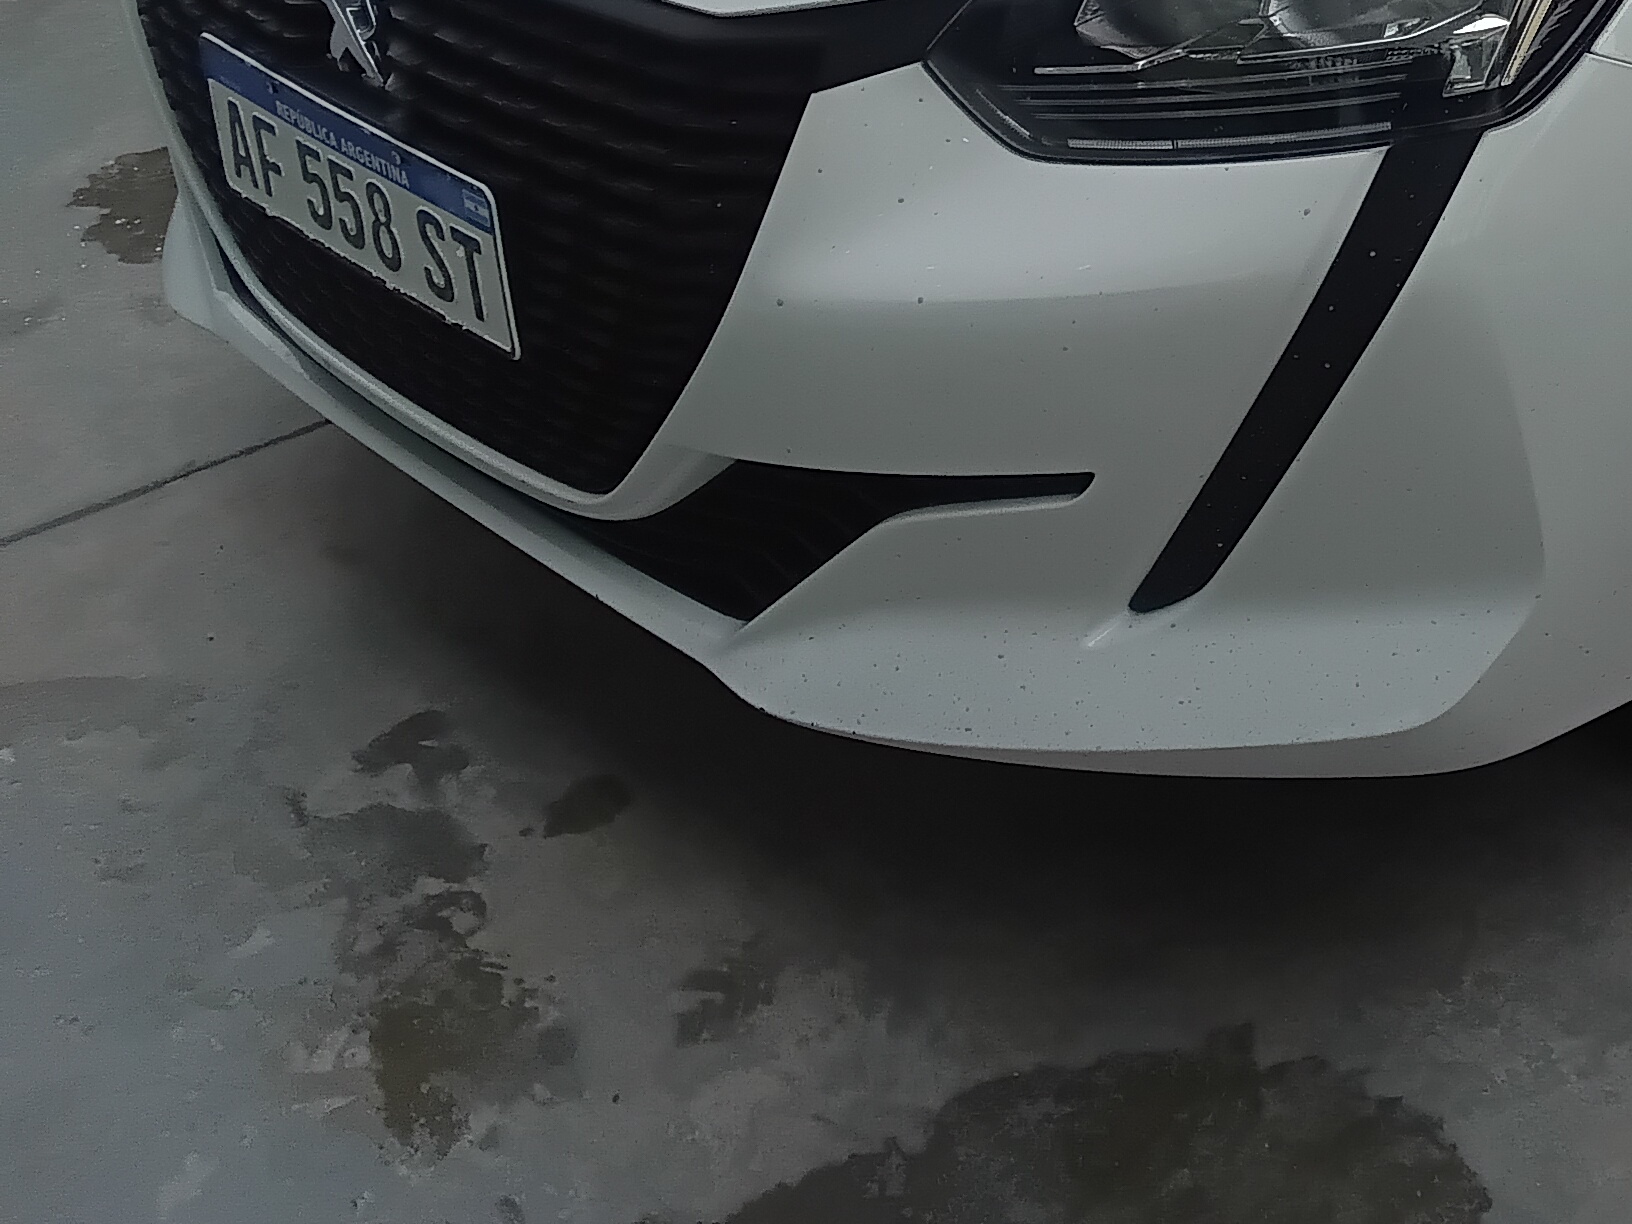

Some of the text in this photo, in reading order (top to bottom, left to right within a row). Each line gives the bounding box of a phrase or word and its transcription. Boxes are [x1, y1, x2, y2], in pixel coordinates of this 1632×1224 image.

[227, 97, 485, 322] AF 558 ST
[275, 99, 410, 190] REPÚBLICA ARGENTINA
